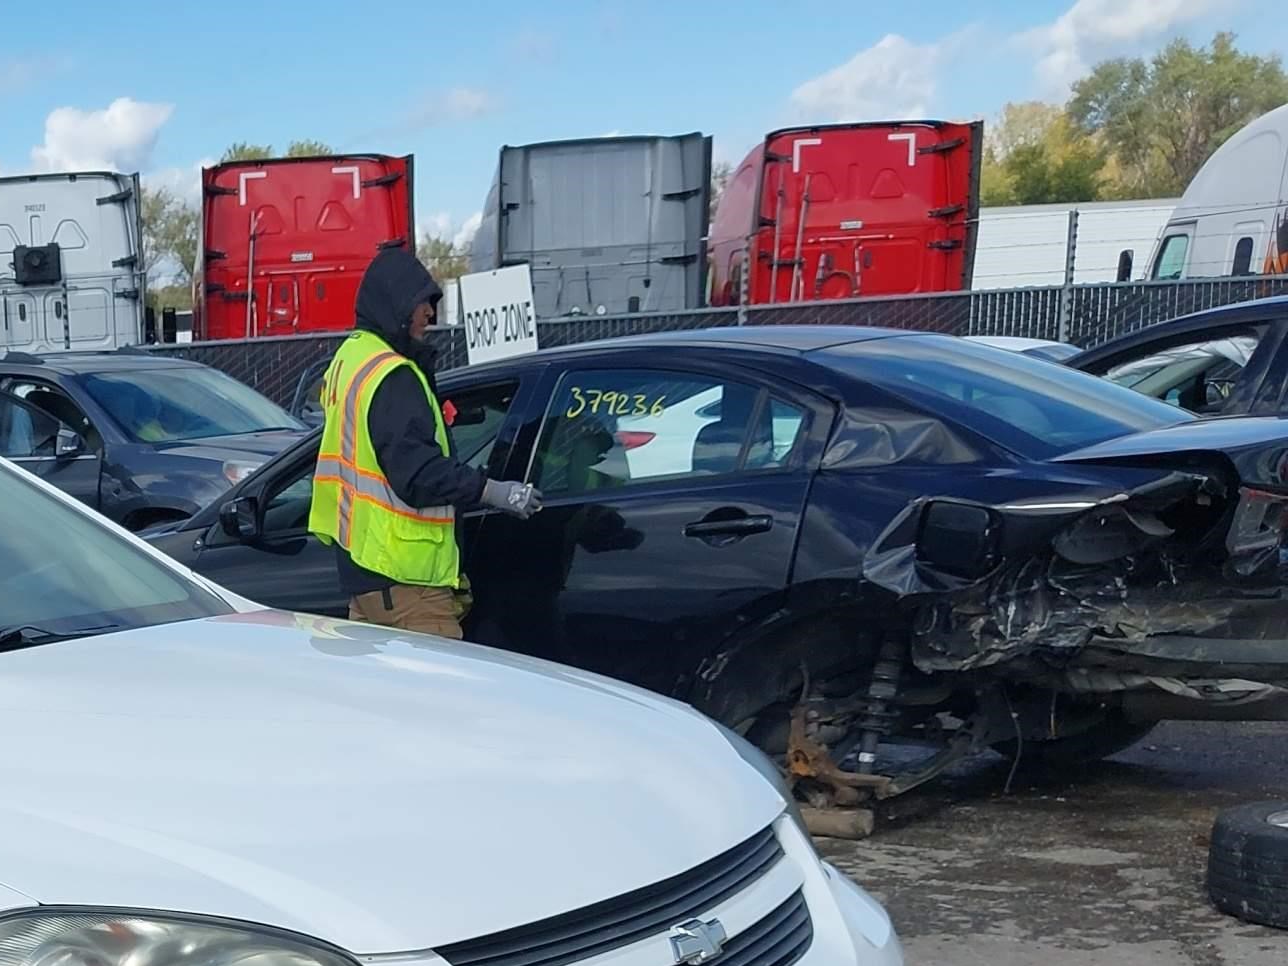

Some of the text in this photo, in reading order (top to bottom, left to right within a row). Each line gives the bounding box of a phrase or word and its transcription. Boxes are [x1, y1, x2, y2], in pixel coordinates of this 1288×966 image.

[467, 302, 534, 349] DROP ZONE
[567, 387, 666, 418] 379236
